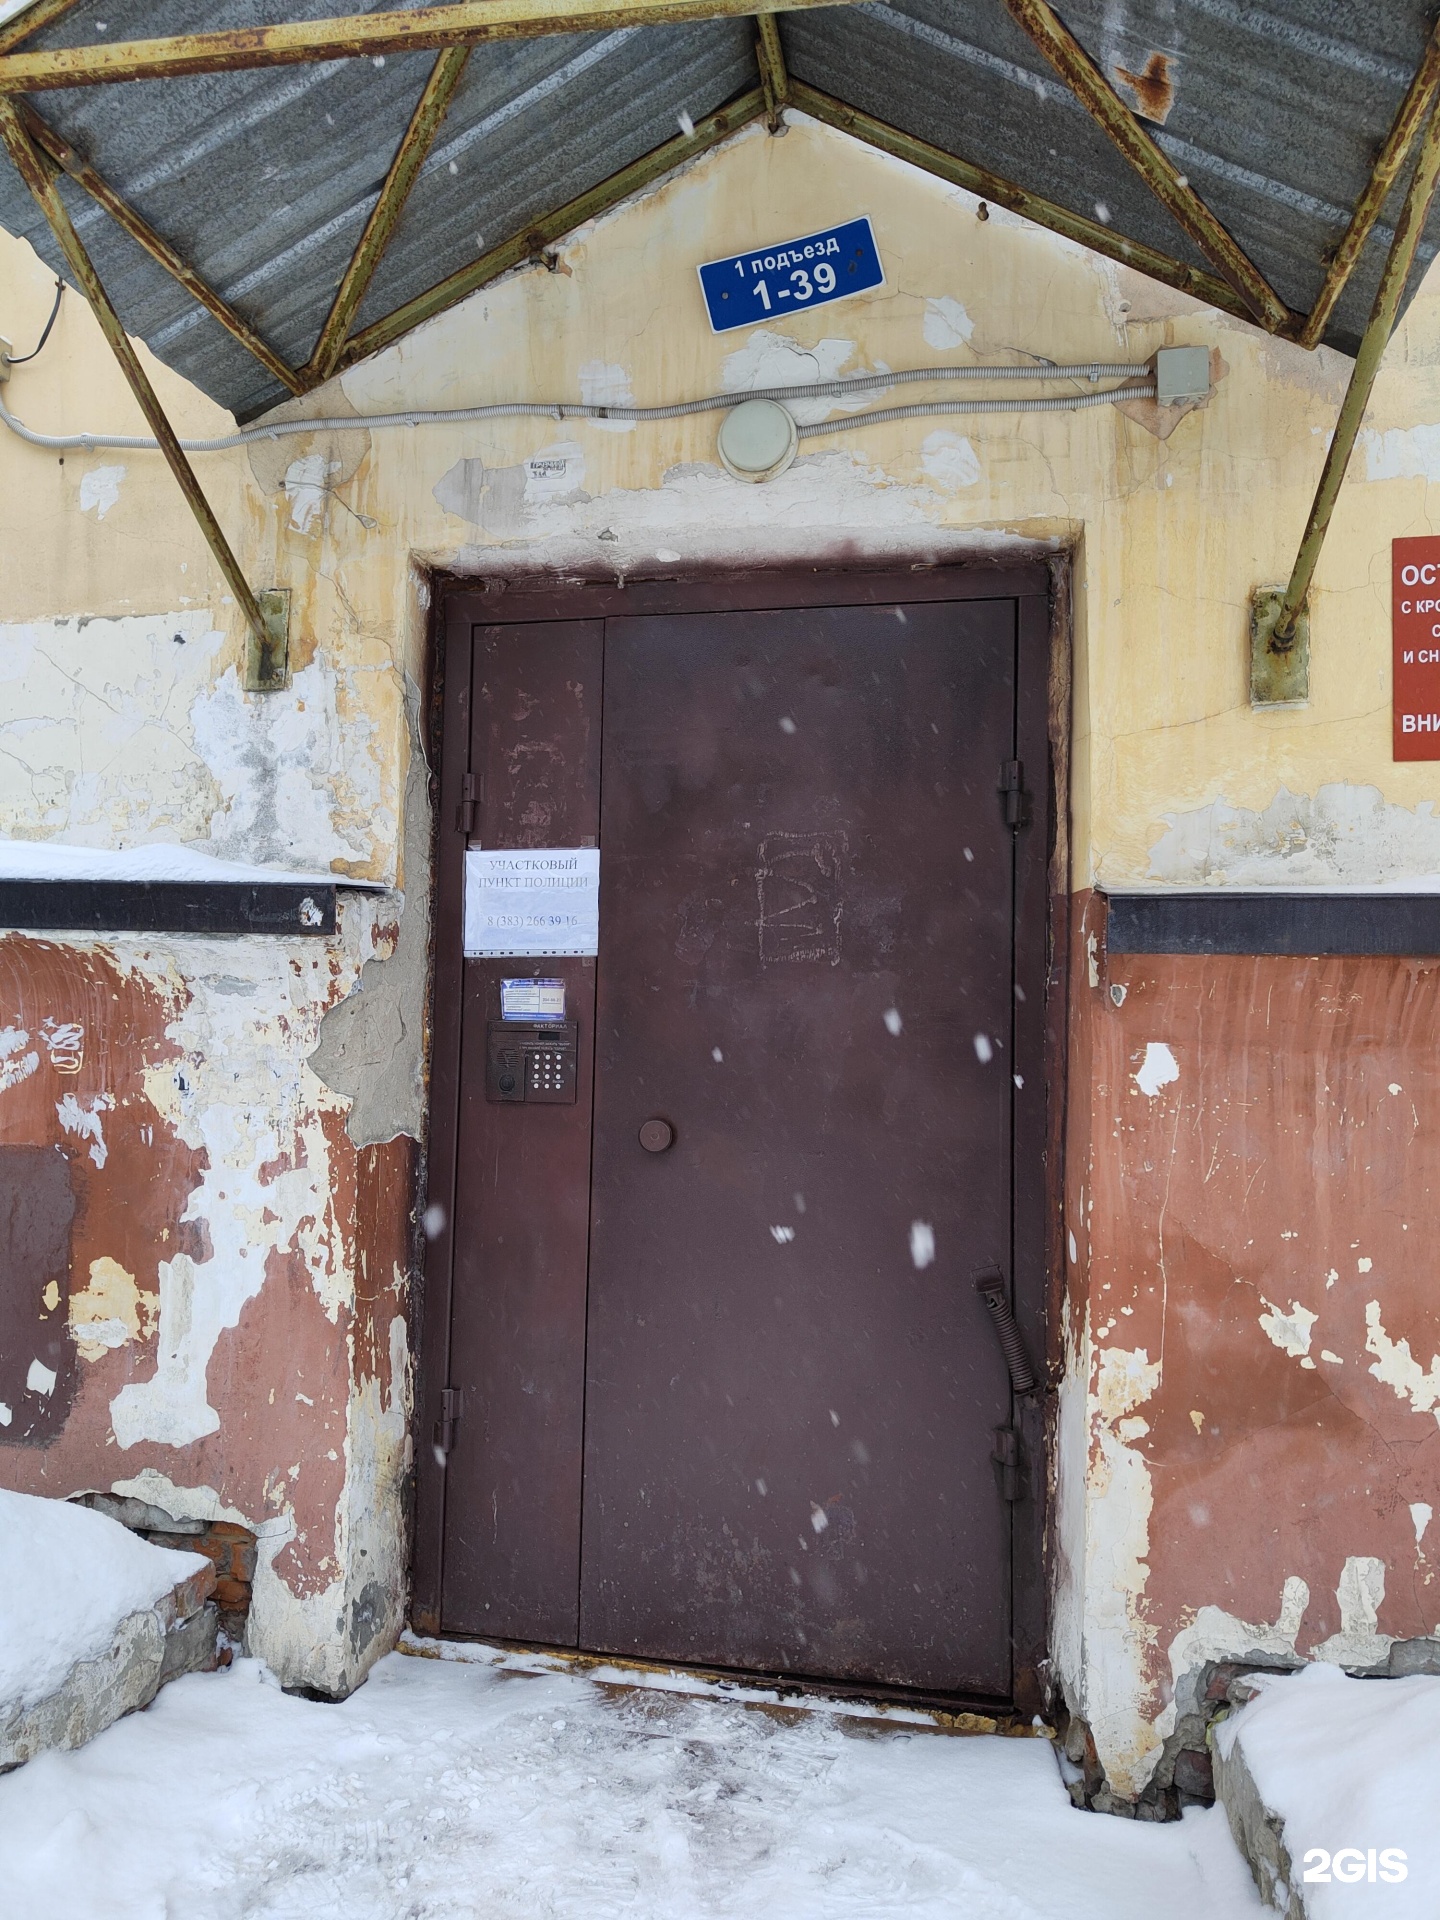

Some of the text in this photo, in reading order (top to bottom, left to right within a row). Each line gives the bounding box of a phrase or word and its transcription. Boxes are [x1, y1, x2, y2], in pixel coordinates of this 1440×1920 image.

[734, 237, 840, 277] 1 подъезд
[752, 262, 837, 310] 1-39
[1401, 562, 1440, 586] ОС
[1401, 600, 1412, 614] С
[1403, 650, 1414, 664] И
[489, 858, 578, 871] УЧАСТКОВЫЙ
[478, 877, 589, 889] ПУНКТ ПОЛИЦИИ
[487, 915, 578, 928] 8 (383) 266 39 16
